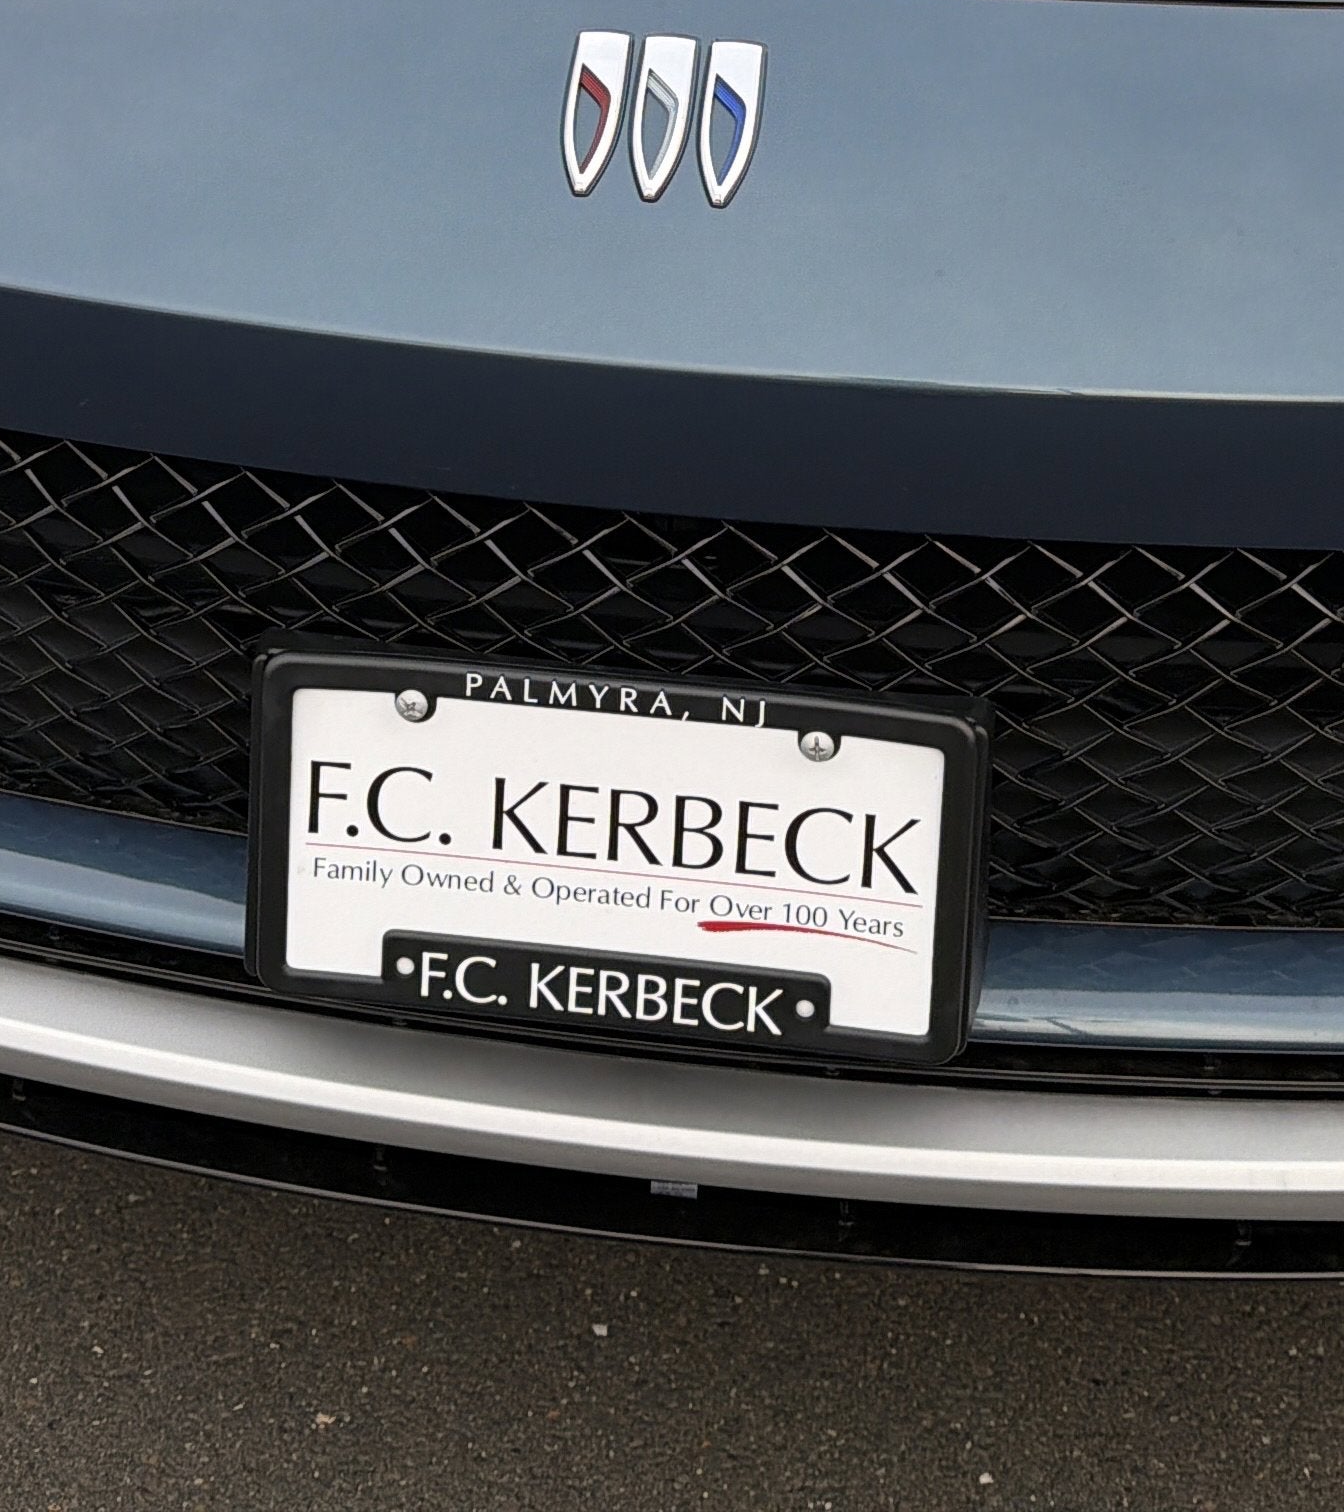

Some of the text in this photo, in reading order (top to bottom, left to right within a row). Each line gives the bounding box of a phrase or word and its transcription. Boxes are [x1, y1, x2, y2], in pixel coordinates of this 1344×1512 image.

[464, 672, 767, 728] PALMYRA, NJ
[307, 759, 922, 896] F.C. KERBECK
[312, 856, 905, 938] Family Owned & Operated For Over 100 Years
[419, 951, 784, 1036] F.C. KERBECK
